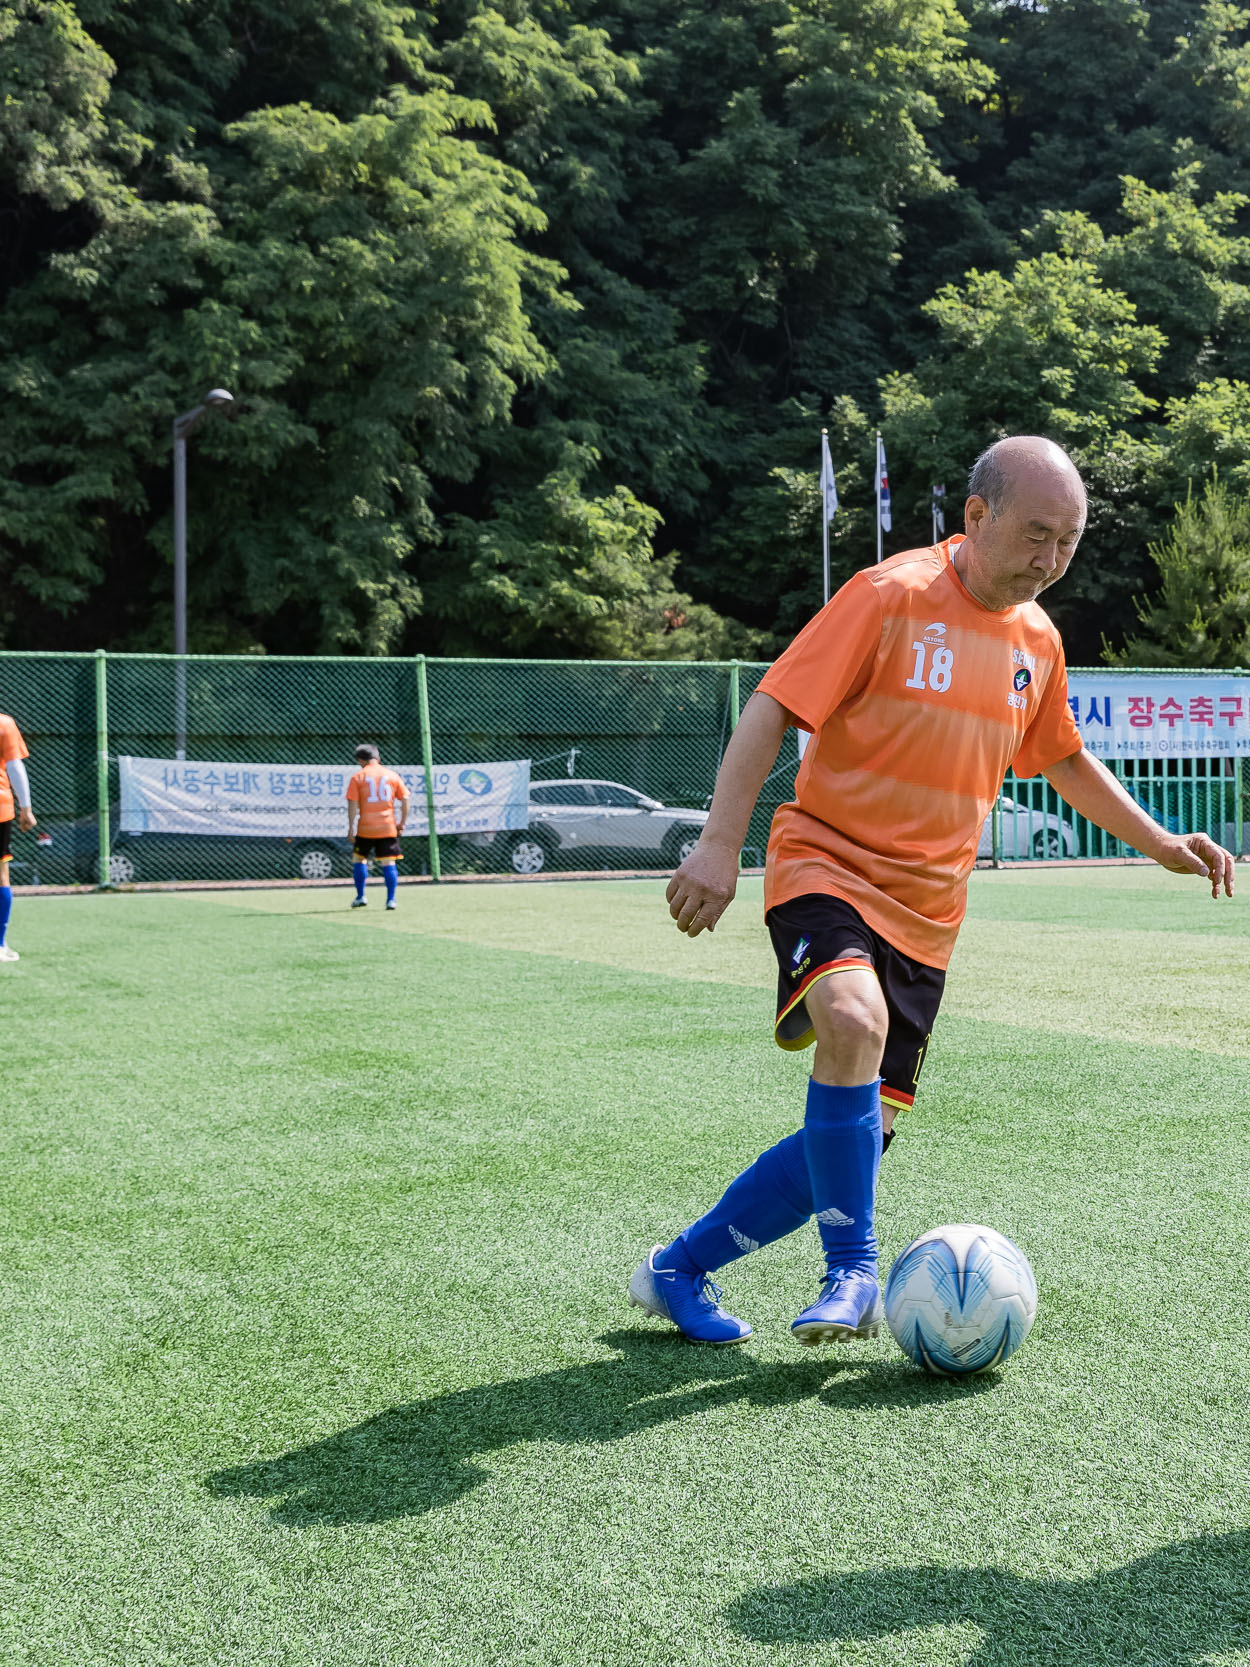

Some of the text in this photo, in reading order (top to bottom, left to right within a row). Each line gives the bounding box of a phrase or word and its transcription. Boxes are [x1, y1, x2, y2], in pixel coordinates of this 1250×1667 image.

[905, 641, 954, 693] 18
[1013, 648, 1035, 671] SEOUL
[365, 776, 392, 803] 16
